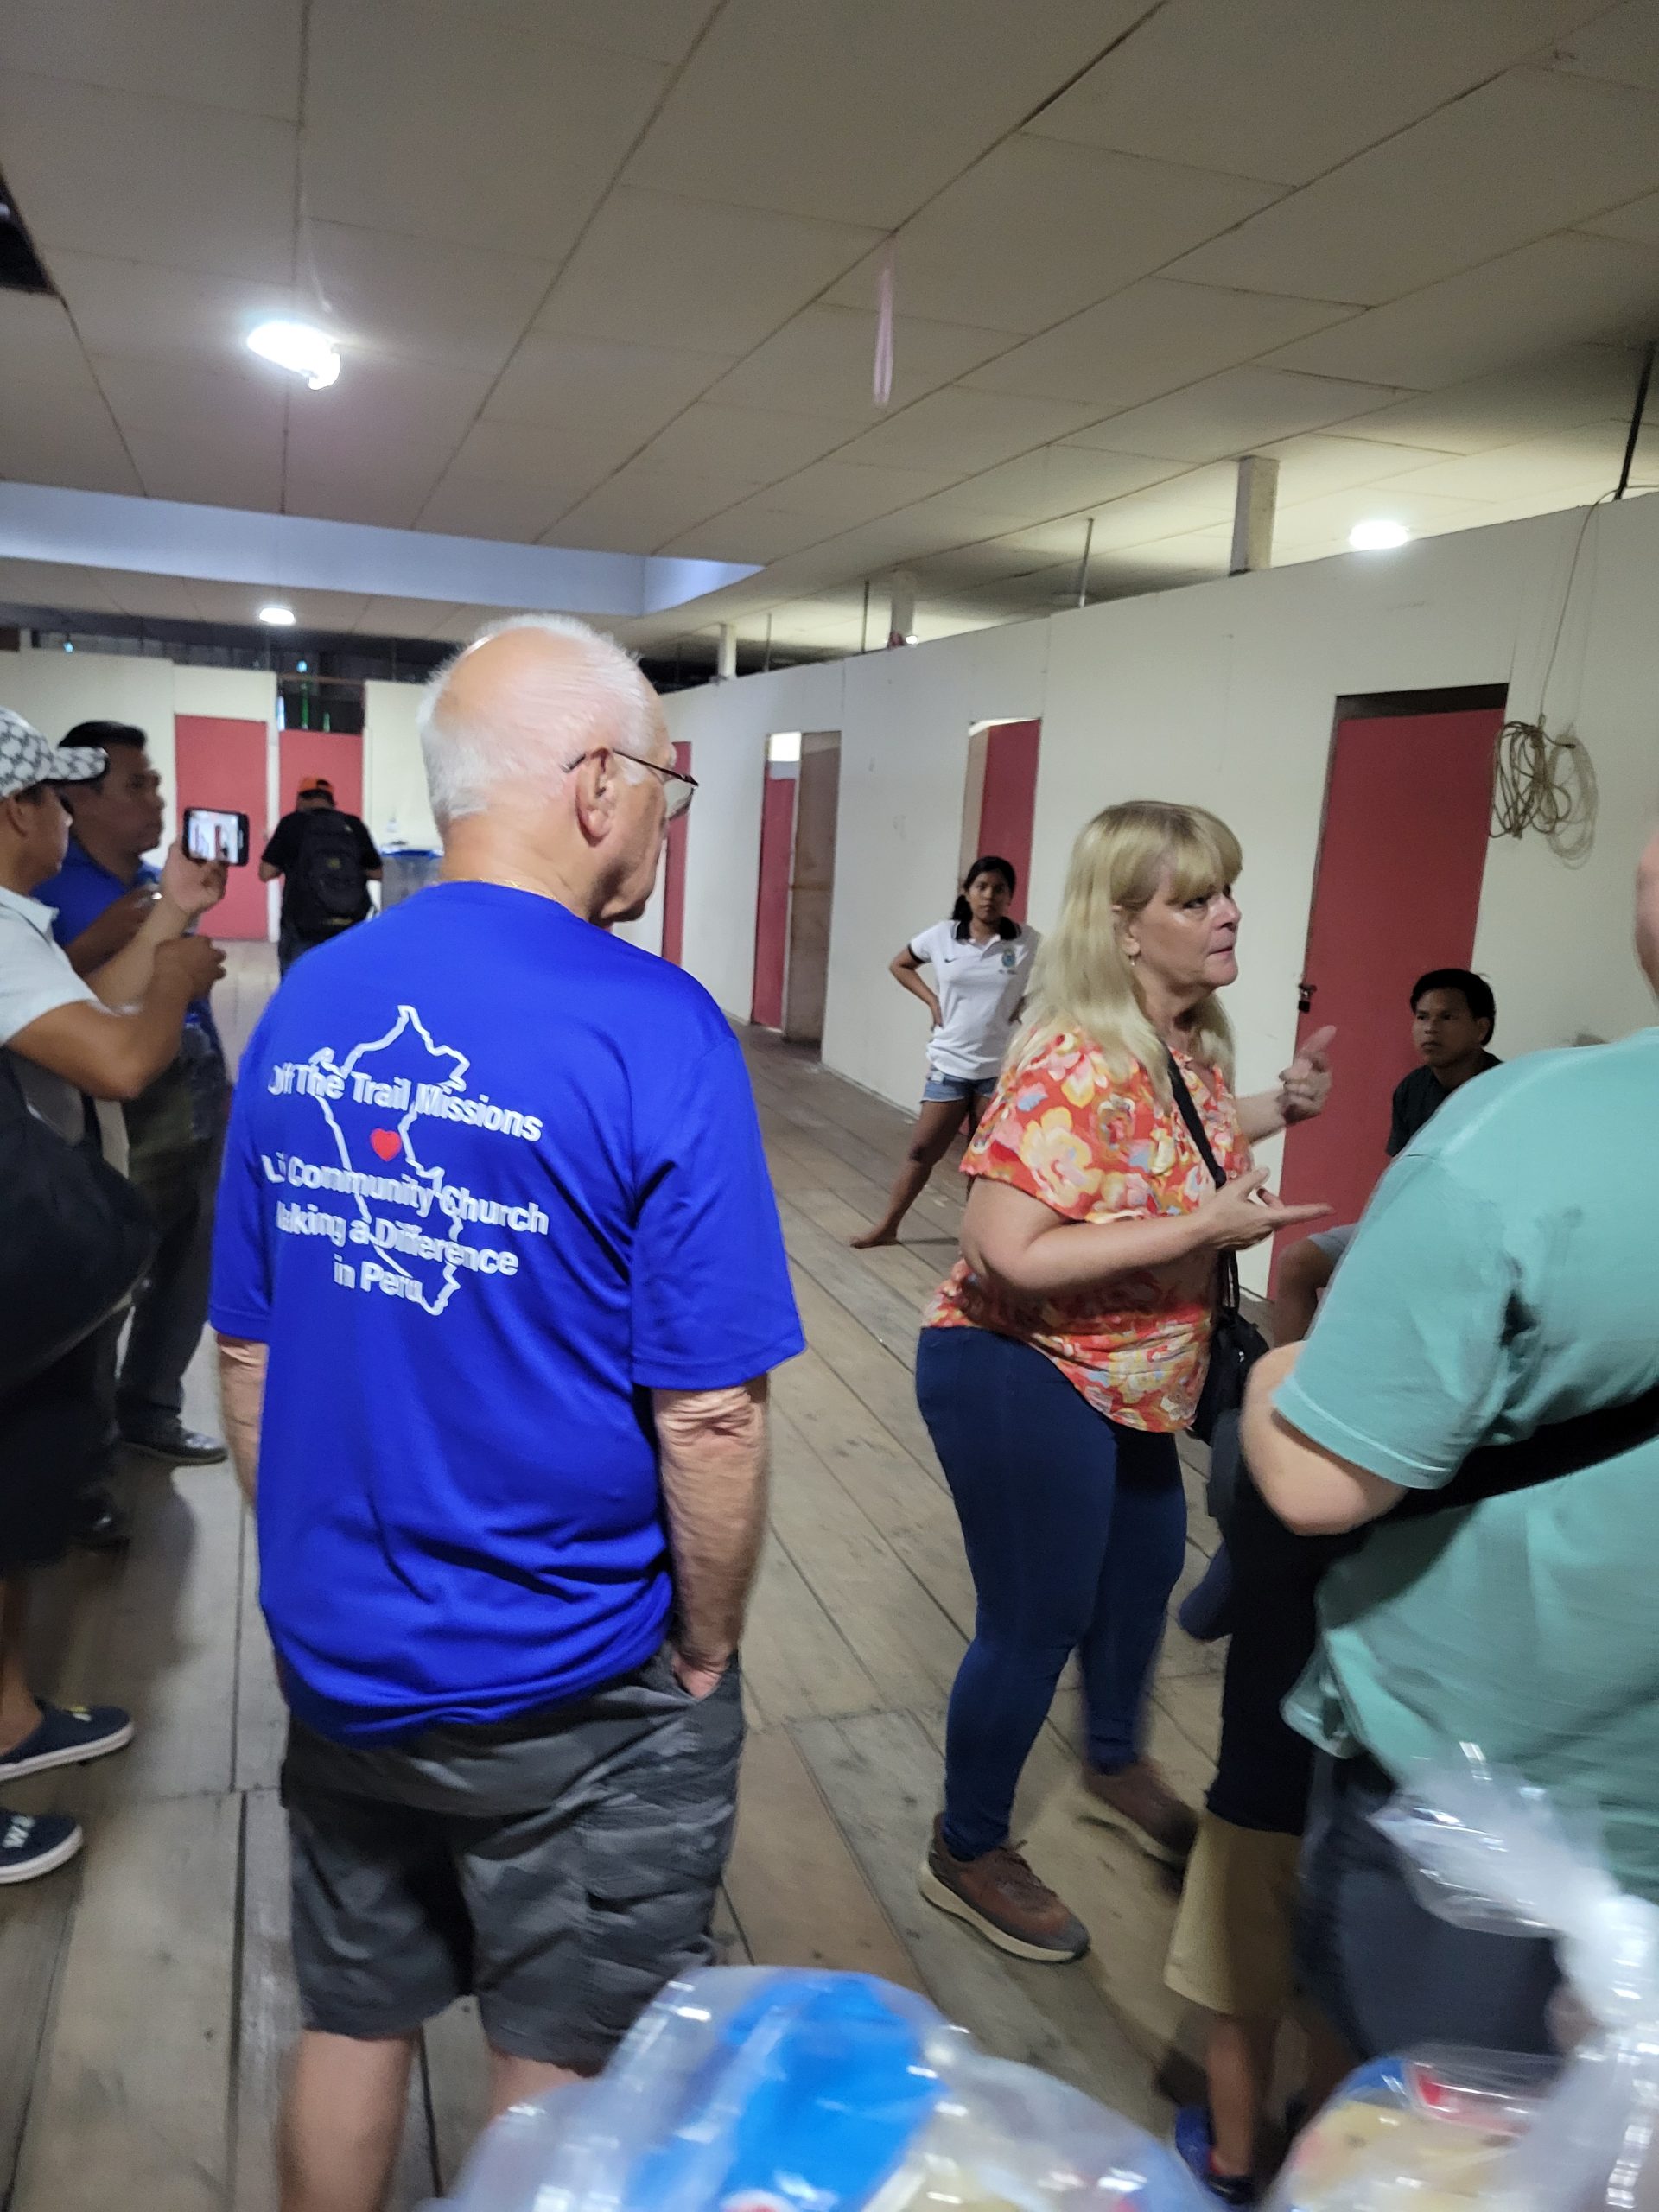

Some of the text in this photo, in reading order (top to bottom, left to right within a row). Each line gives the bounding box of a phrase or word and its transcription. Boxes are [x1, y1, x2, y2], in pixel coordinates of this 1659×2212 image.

[294, 1063, 345, 1099] The
[350, 1071, 412, 1111] Trail
[415, 1084, 543, 1141] Missions
[289, 1156, 432, 1217] Community
[439, 1185, 549, 1235] Church
[334, 1254, 423, 1302] in Peru
[348, 1219, 371, 1245] a
[375, 1217, 519, 1276] Difference
